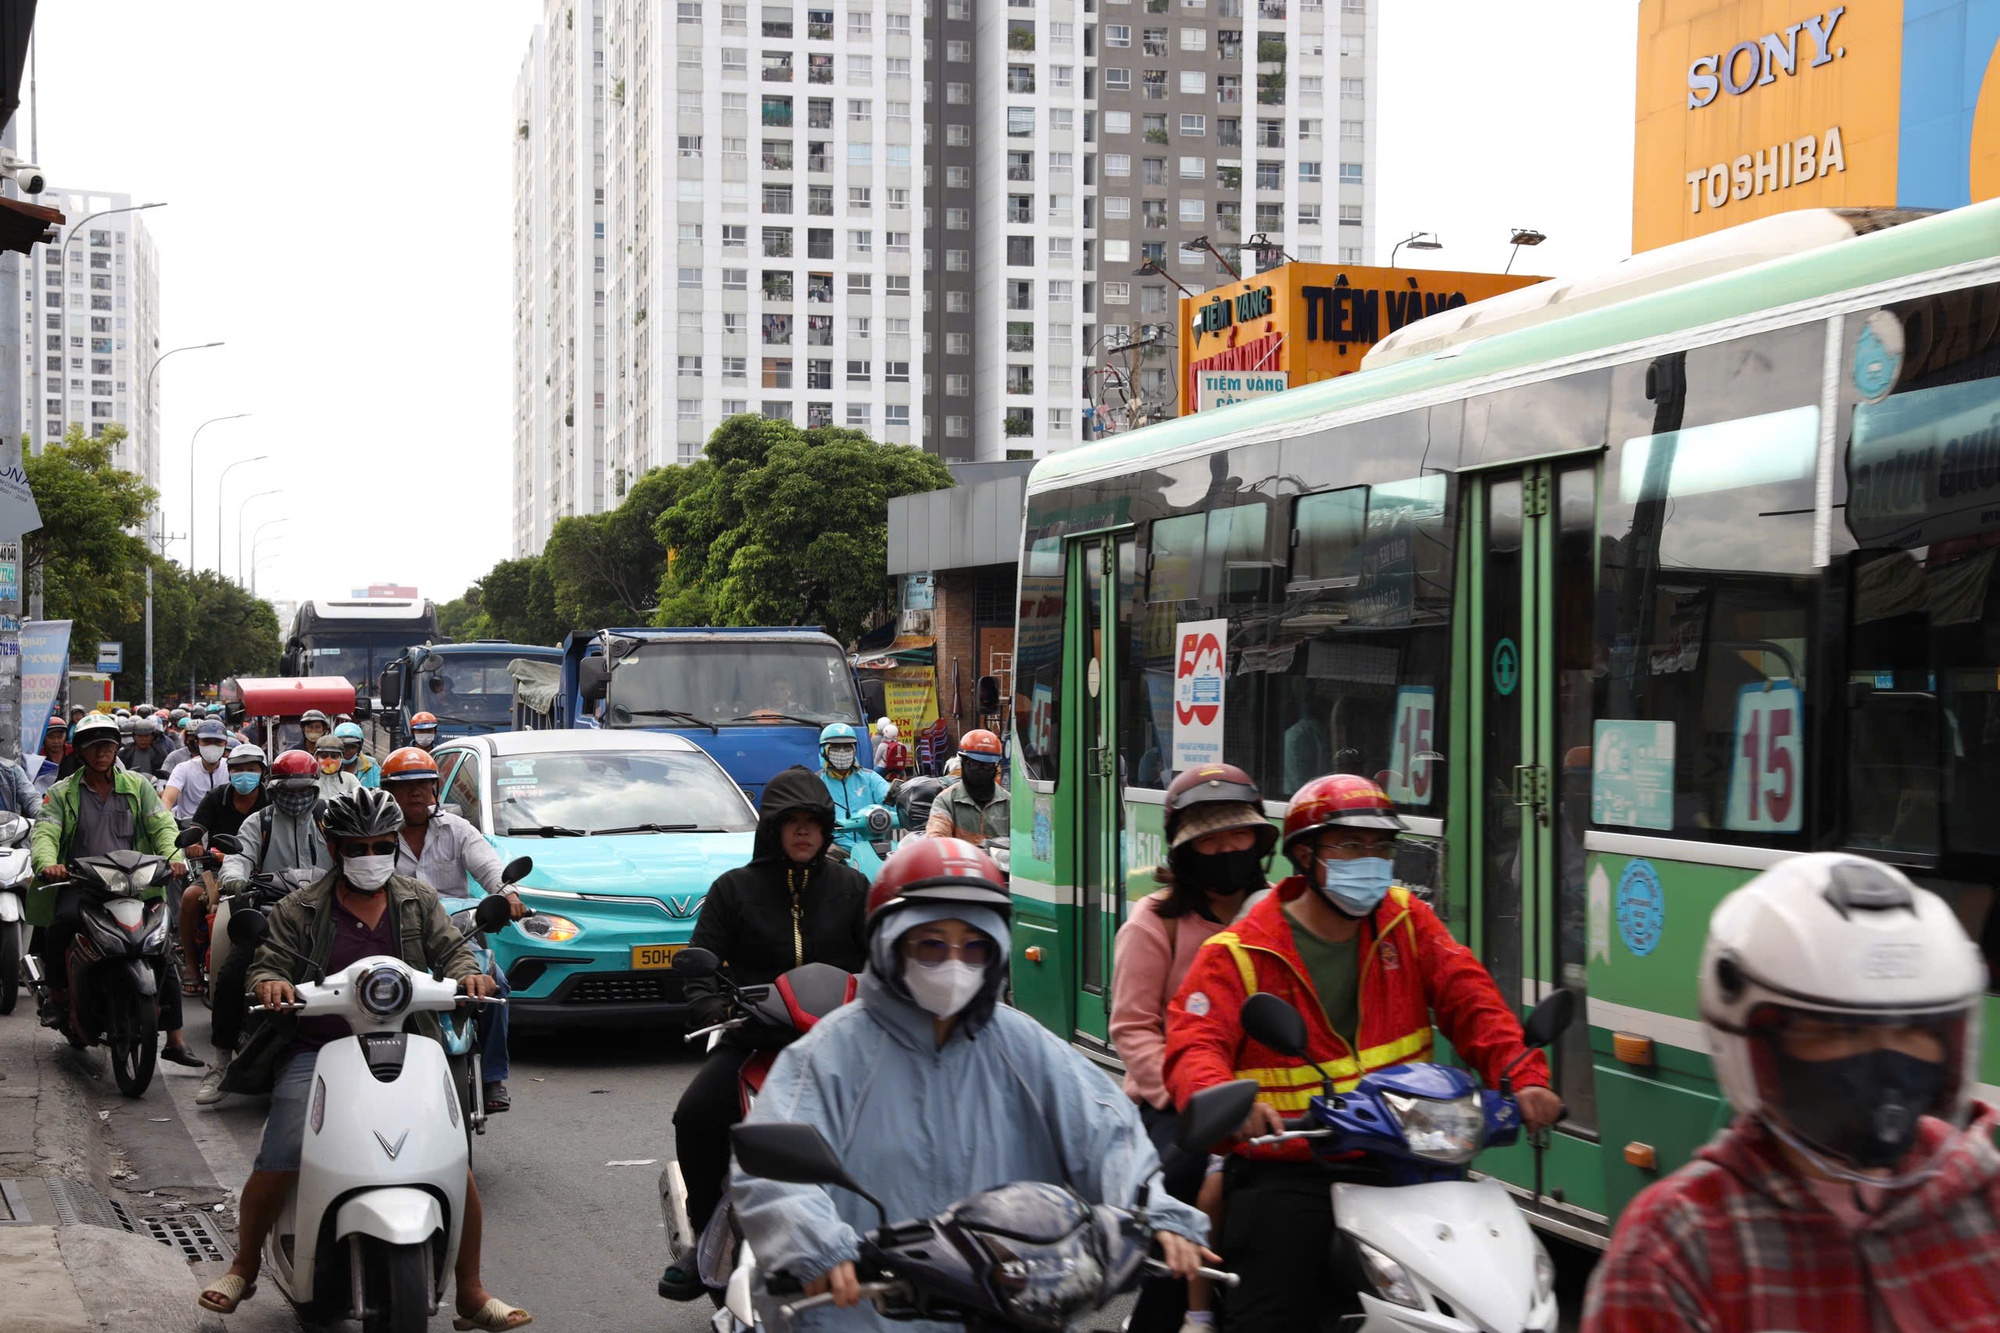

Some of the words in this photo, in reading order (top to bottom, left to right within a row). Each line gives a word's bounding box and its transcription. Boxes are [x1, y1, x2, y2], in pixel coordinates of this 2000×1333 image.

[1686, 126, 1847, 214] TOSHIBA
[1199, 295, 1232, 338] TIỆM
[1235, 284, 1273, 323] VÀNG
[1302, 273, 1379, 355] TIỆM
[1205, 375, 1242, 393] TIỆM
[1246, 376, 1284, 392] VÀNG
[1399, 705, 1431, 798] 15
[1741, 708, 1794, 823] 15
[641, 949, 671, 965] 50H
